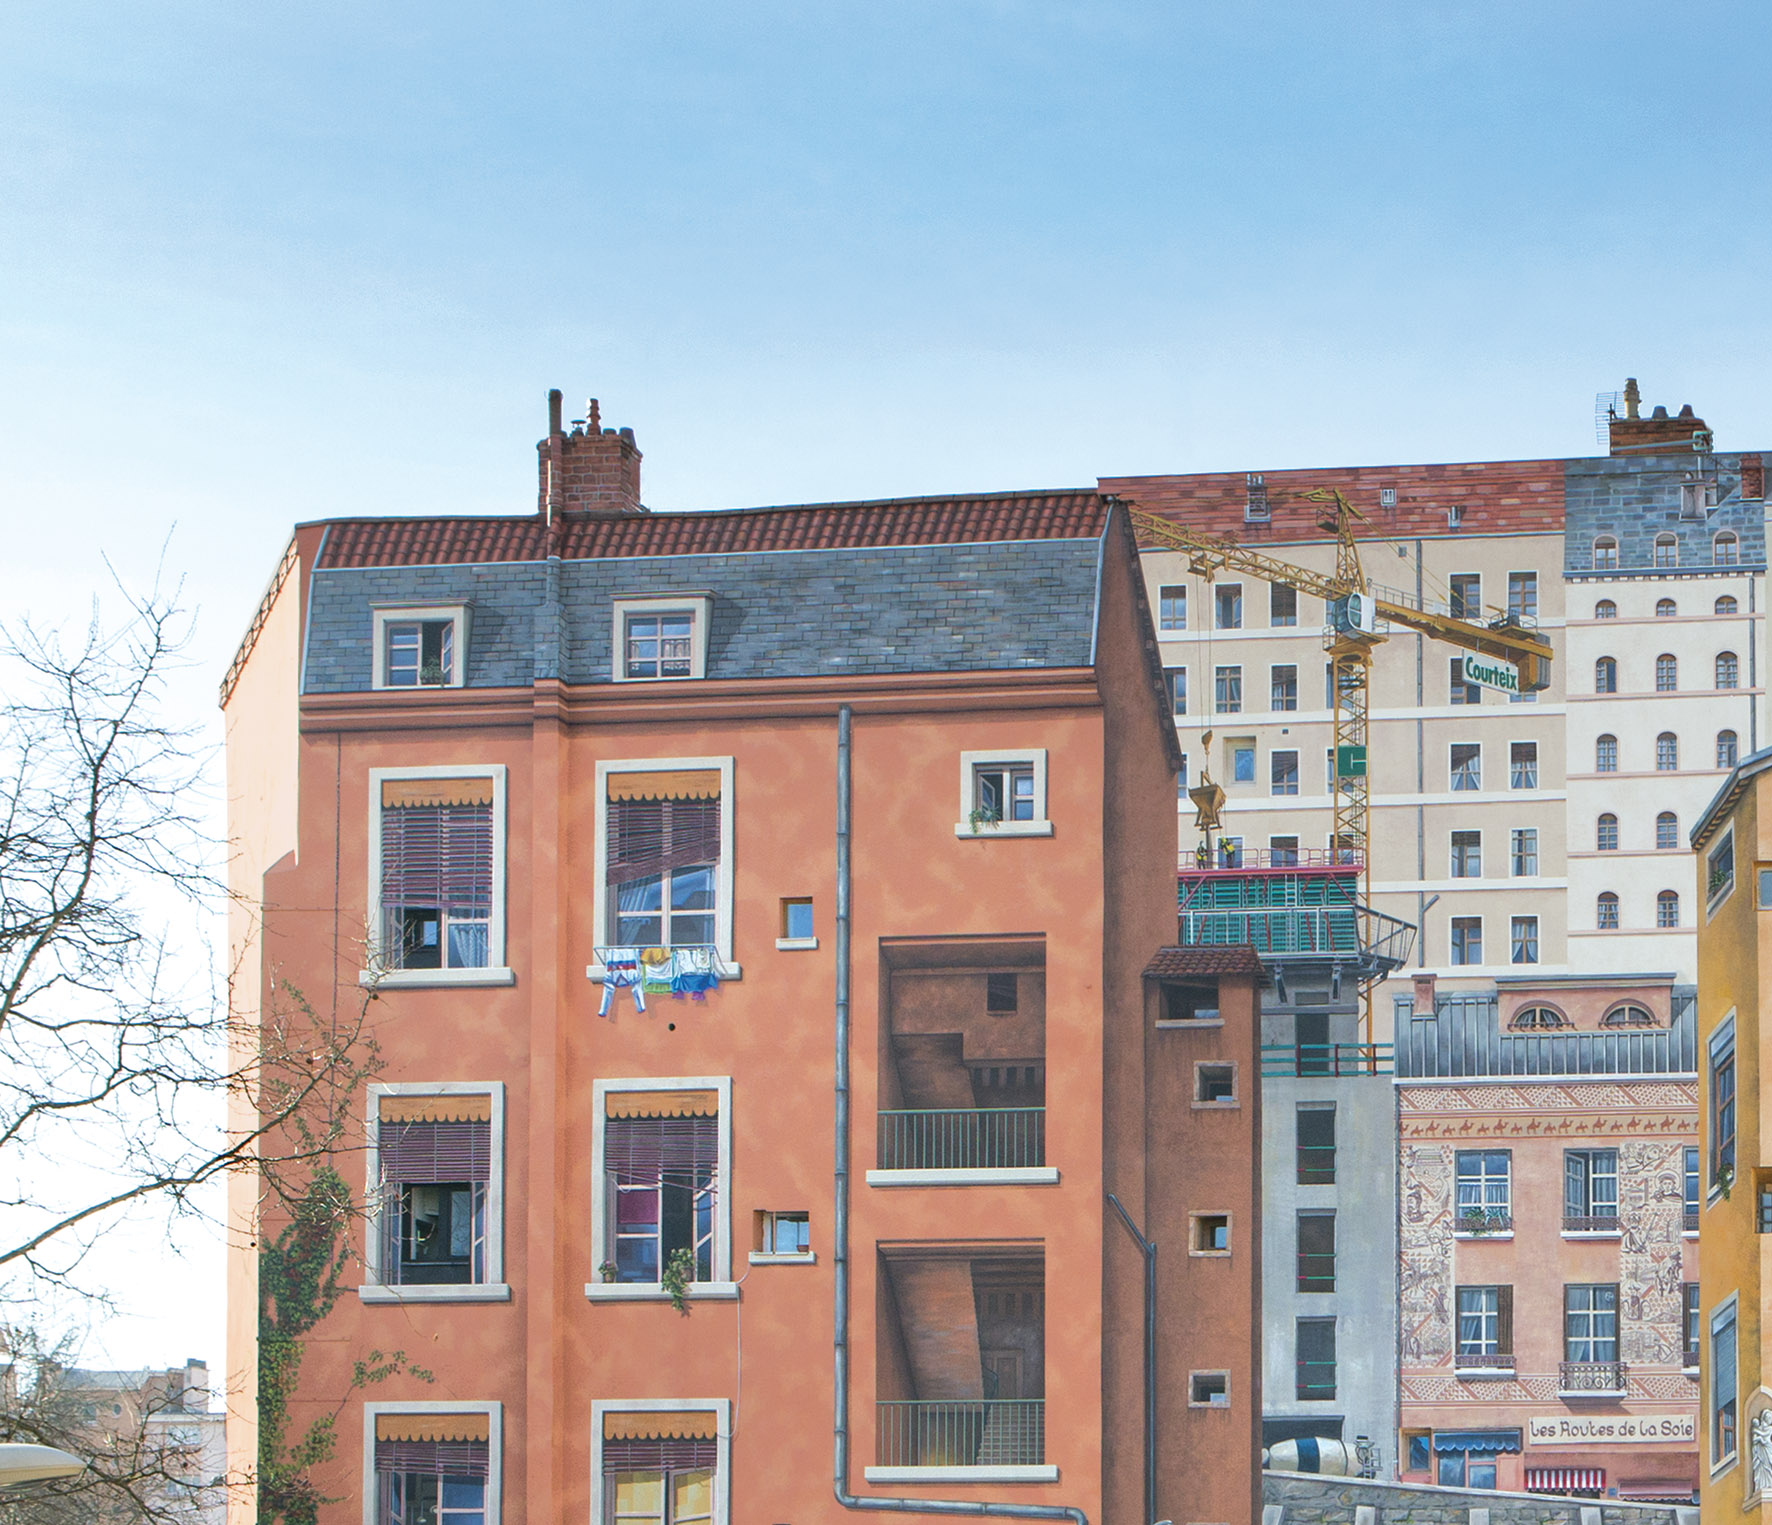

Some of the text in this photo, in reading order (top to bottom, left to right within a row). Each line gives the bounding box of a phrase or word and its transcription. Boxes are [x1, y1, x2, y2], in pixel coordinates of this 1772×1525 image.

[1465, 656, 1517, 690] Courteix
[1530, 1420, 1556, 1437] Les
[1559, 1420, 1614, 1437] Routes
[1618, 1420, 1636, 1436] de
[1660, 1419, 1693, 1437] Soie
